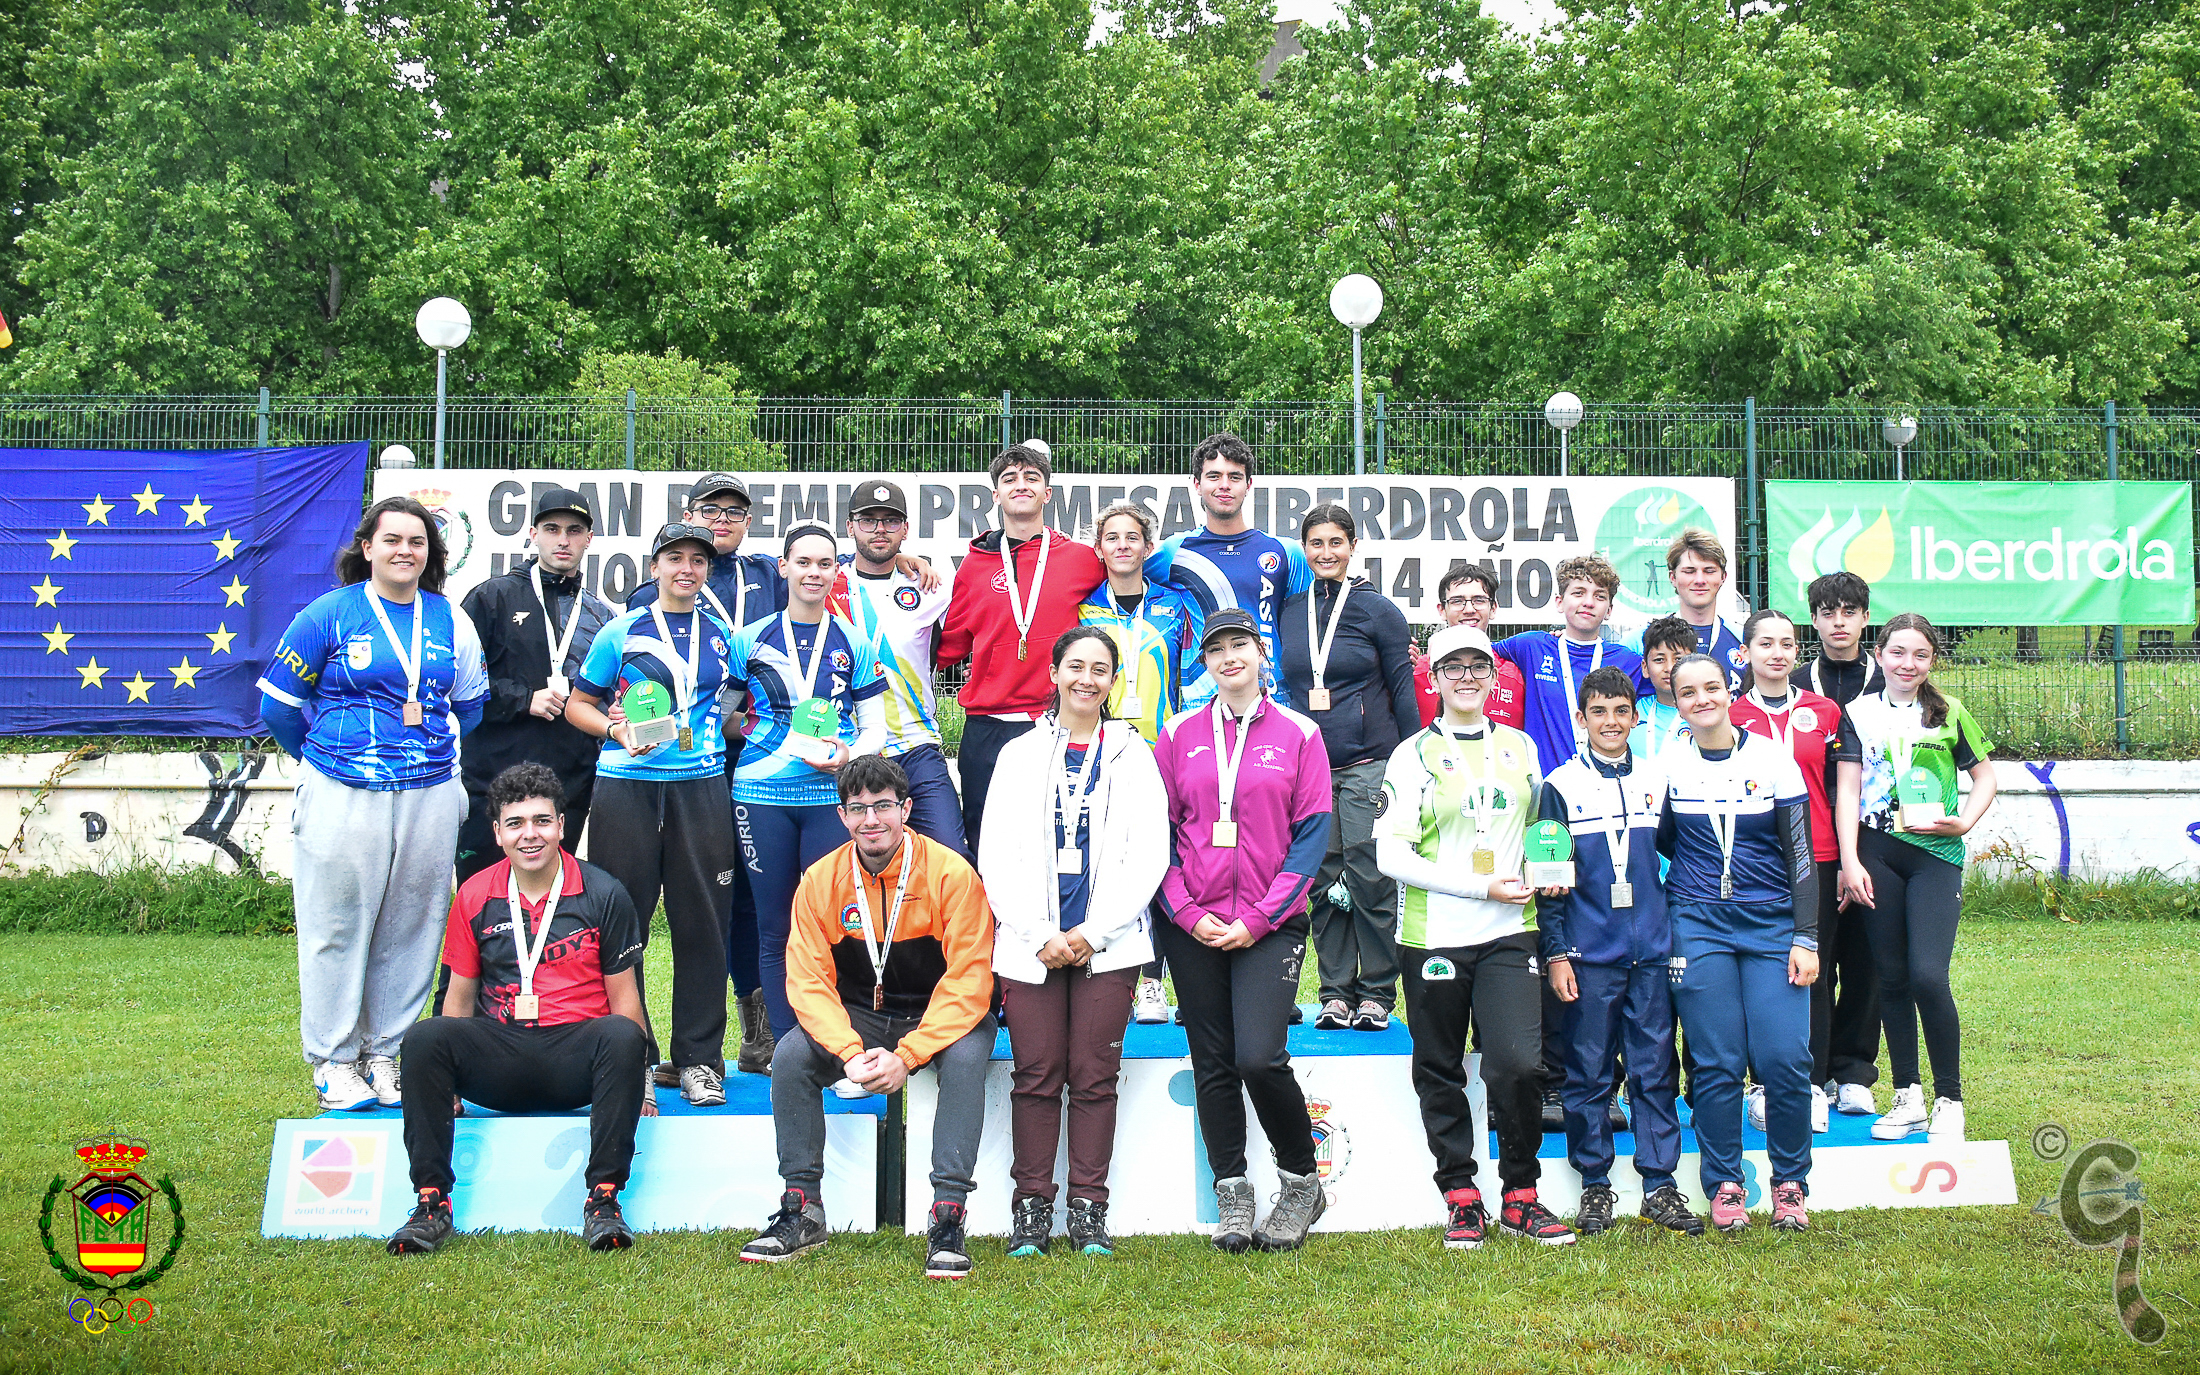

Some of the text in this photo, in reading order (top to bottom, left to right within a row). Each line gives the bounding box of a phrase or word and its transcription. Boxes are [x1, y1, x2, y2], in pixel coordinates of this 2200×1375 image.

[668, 483, 850, 539] PEMI
[1633, 536, 1674, 546] Iberdrol
[1910, 526, 2175, 580] Iberdrola
[1364, 557, 1423, 607] 14
[425, 677, 438, 745] MARTN
[735, 805, 763, 873] ASIRIO
[295, 1206, 370, 1216] world archery
